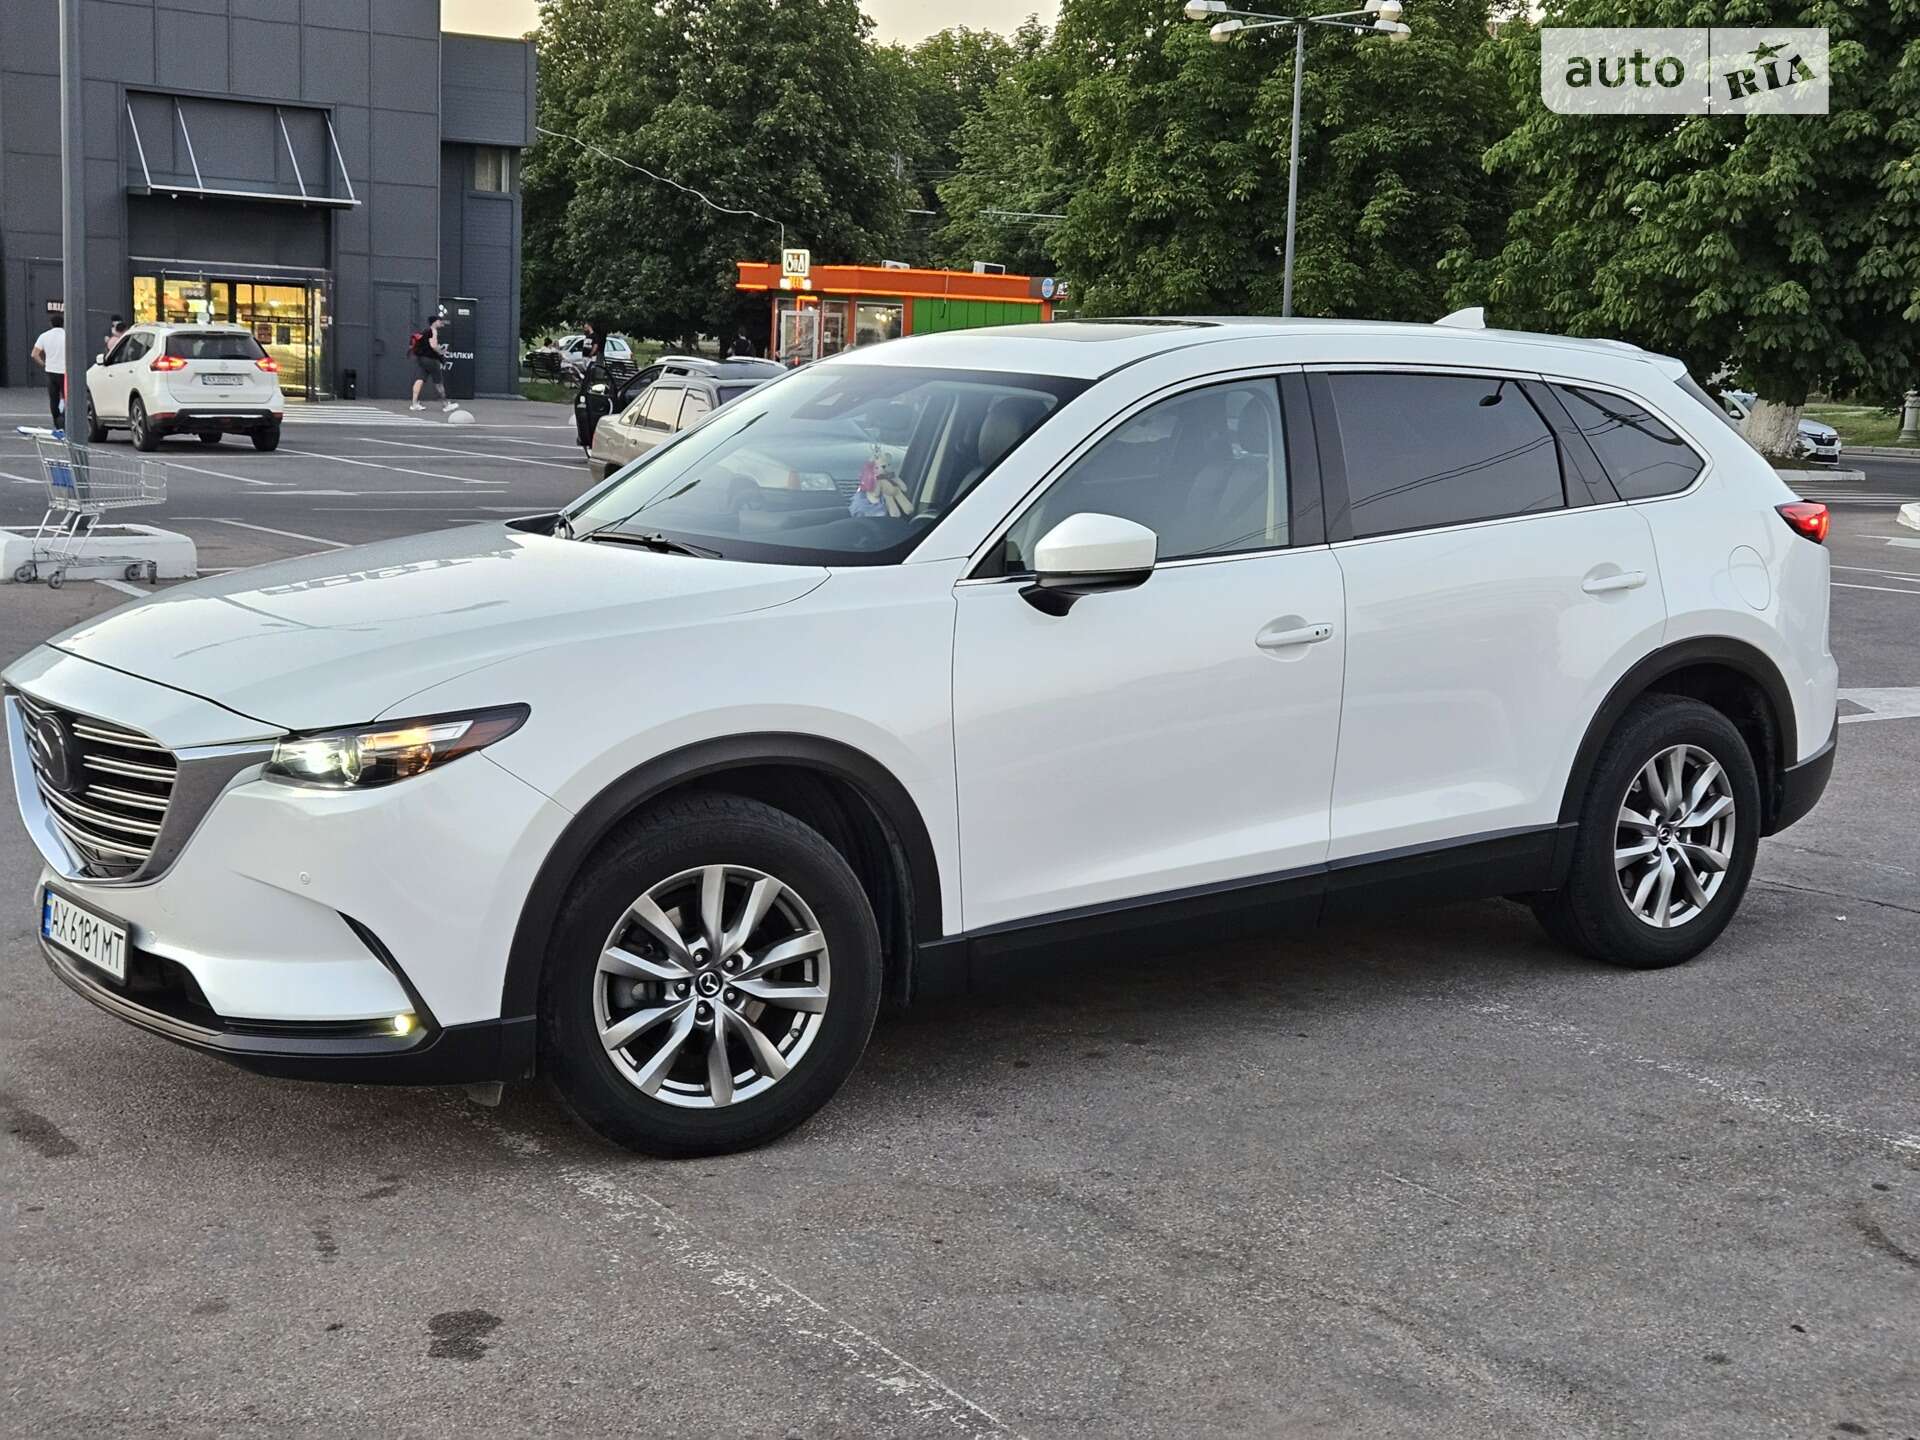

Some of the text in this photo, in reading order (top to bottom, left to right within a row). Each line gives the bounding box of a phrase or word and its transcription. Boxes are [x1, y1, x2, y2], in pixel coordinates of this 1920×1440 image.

[51, 900, 124, 970] AX 6181 MT
